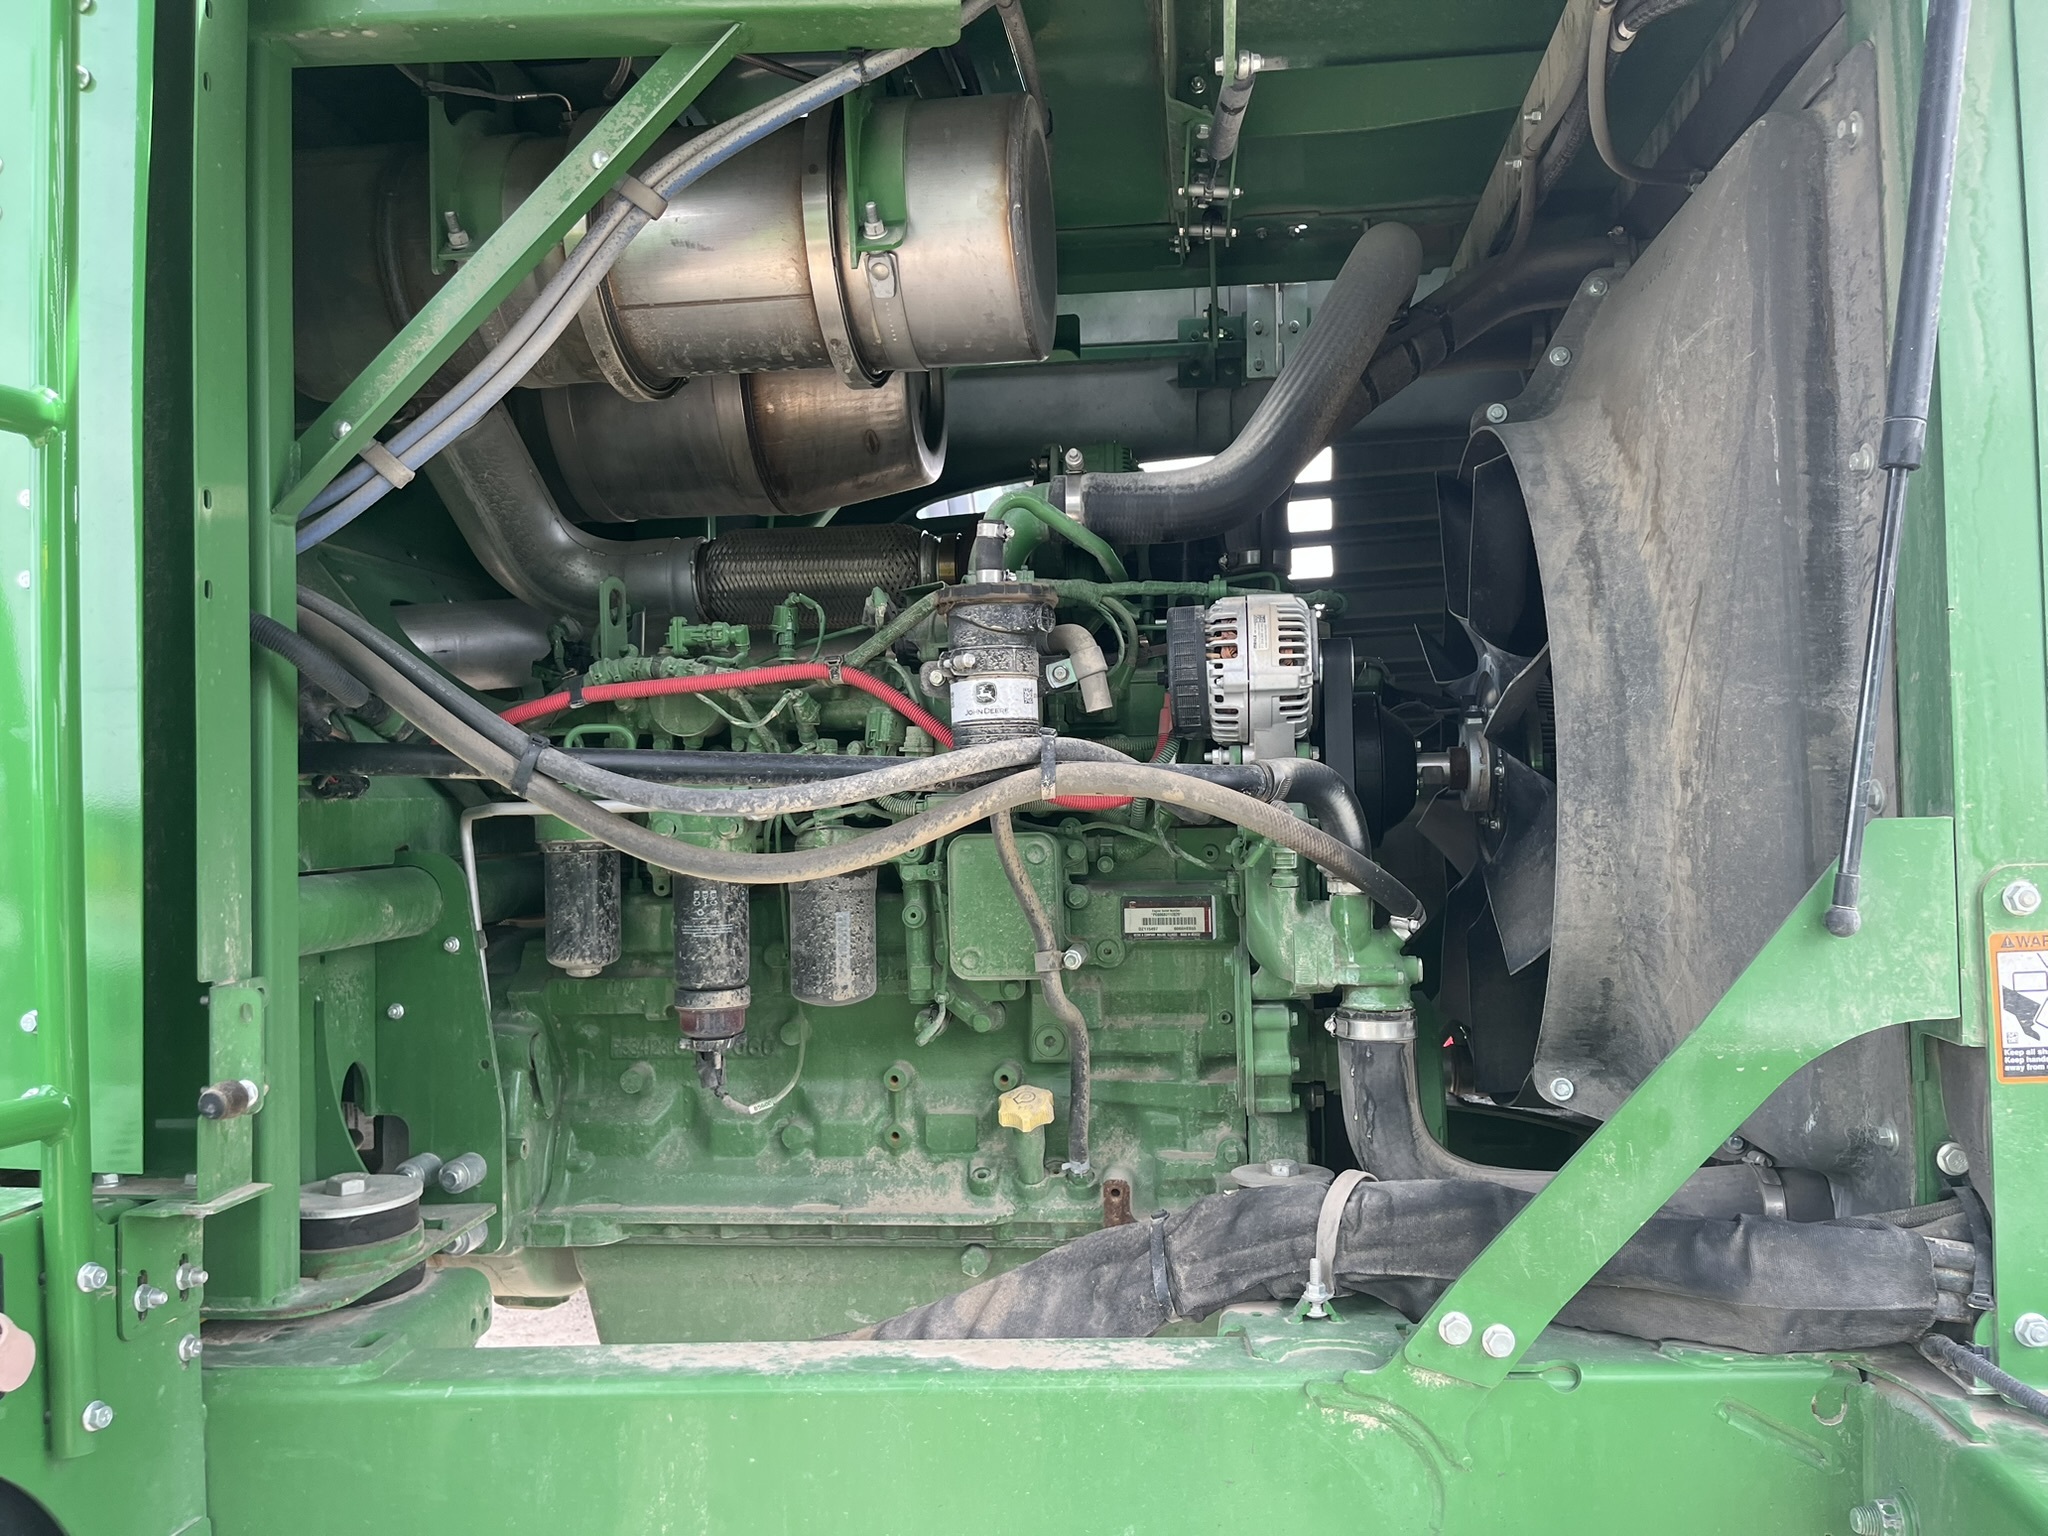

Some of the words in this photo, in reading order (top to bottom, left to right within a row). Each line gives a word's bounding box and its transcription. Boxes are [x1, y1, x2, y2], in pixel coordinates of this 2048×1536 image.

[2003, 1049, 2024, 1057] Keep
[2004, 1057, 2025, 1065] Keep
[2004, 1065, 2025, 1073] away
[2026, 1063, 2045, 1071] from
